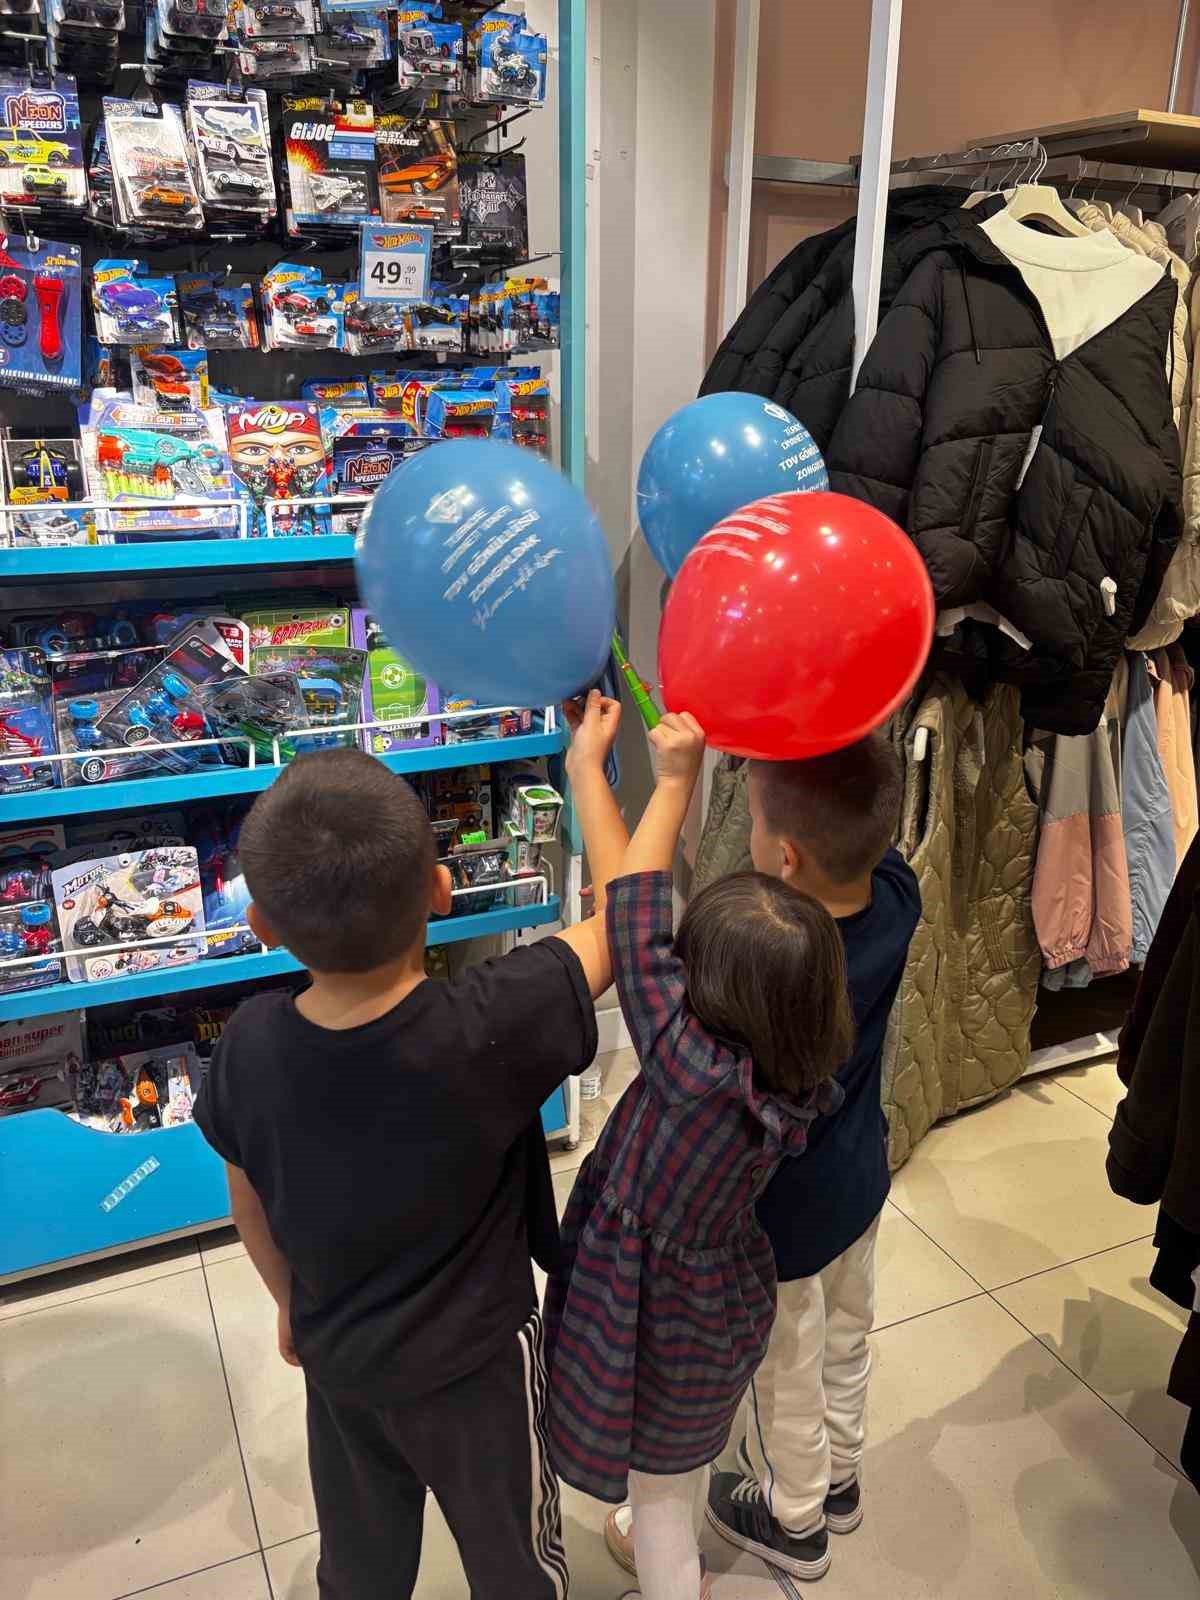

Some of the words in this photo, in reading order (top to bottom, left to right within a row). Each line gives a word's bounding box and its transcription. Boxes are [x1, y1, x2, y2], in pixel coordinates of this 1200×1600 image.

[8, 96, 62, 128] NEON
[19, 120, 63, 129] SPEEDERS
[371, 262, 402, 284] 49
[239, 410, 308, 432] NINJA
[348, 458, 390, 482] NEON
[779, 454, 799, 471] TDV
